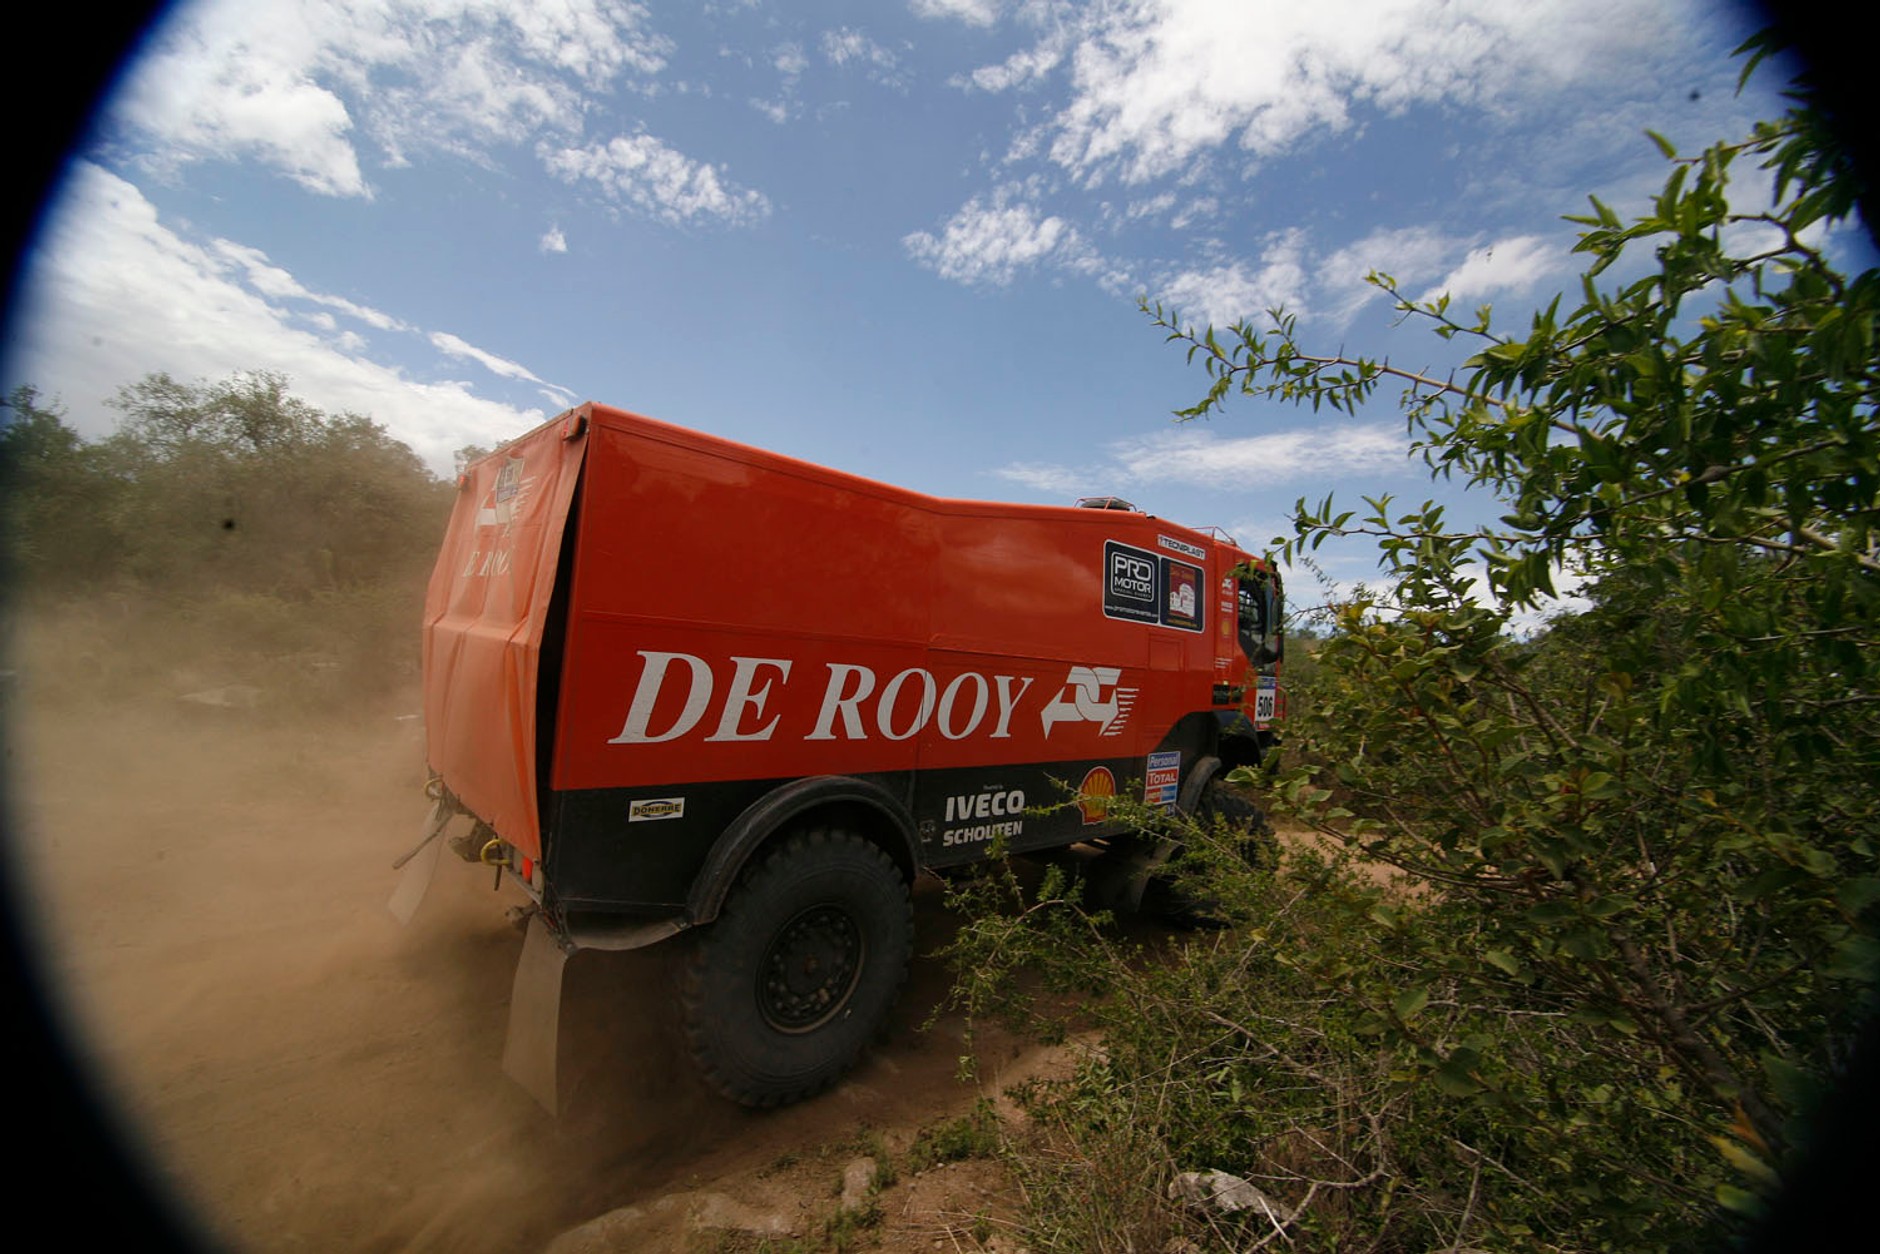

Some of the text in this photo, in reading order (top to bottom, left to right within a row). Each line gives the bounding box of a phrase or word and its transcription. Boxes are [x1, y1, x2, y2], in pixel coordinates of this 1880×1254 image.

[1114, 555, 1151, 581] PRO
[1114, 576, 1152, 594] MOTOR
[606, 650, 1034, 745] DE ROOY
[1257, 695, 1274, 718] 506
[1149, 755, 1178, 768] Personal
[945, 790, 1025, 822] IVECO
[942, 820, 1023, 847] SCHOUTEN
